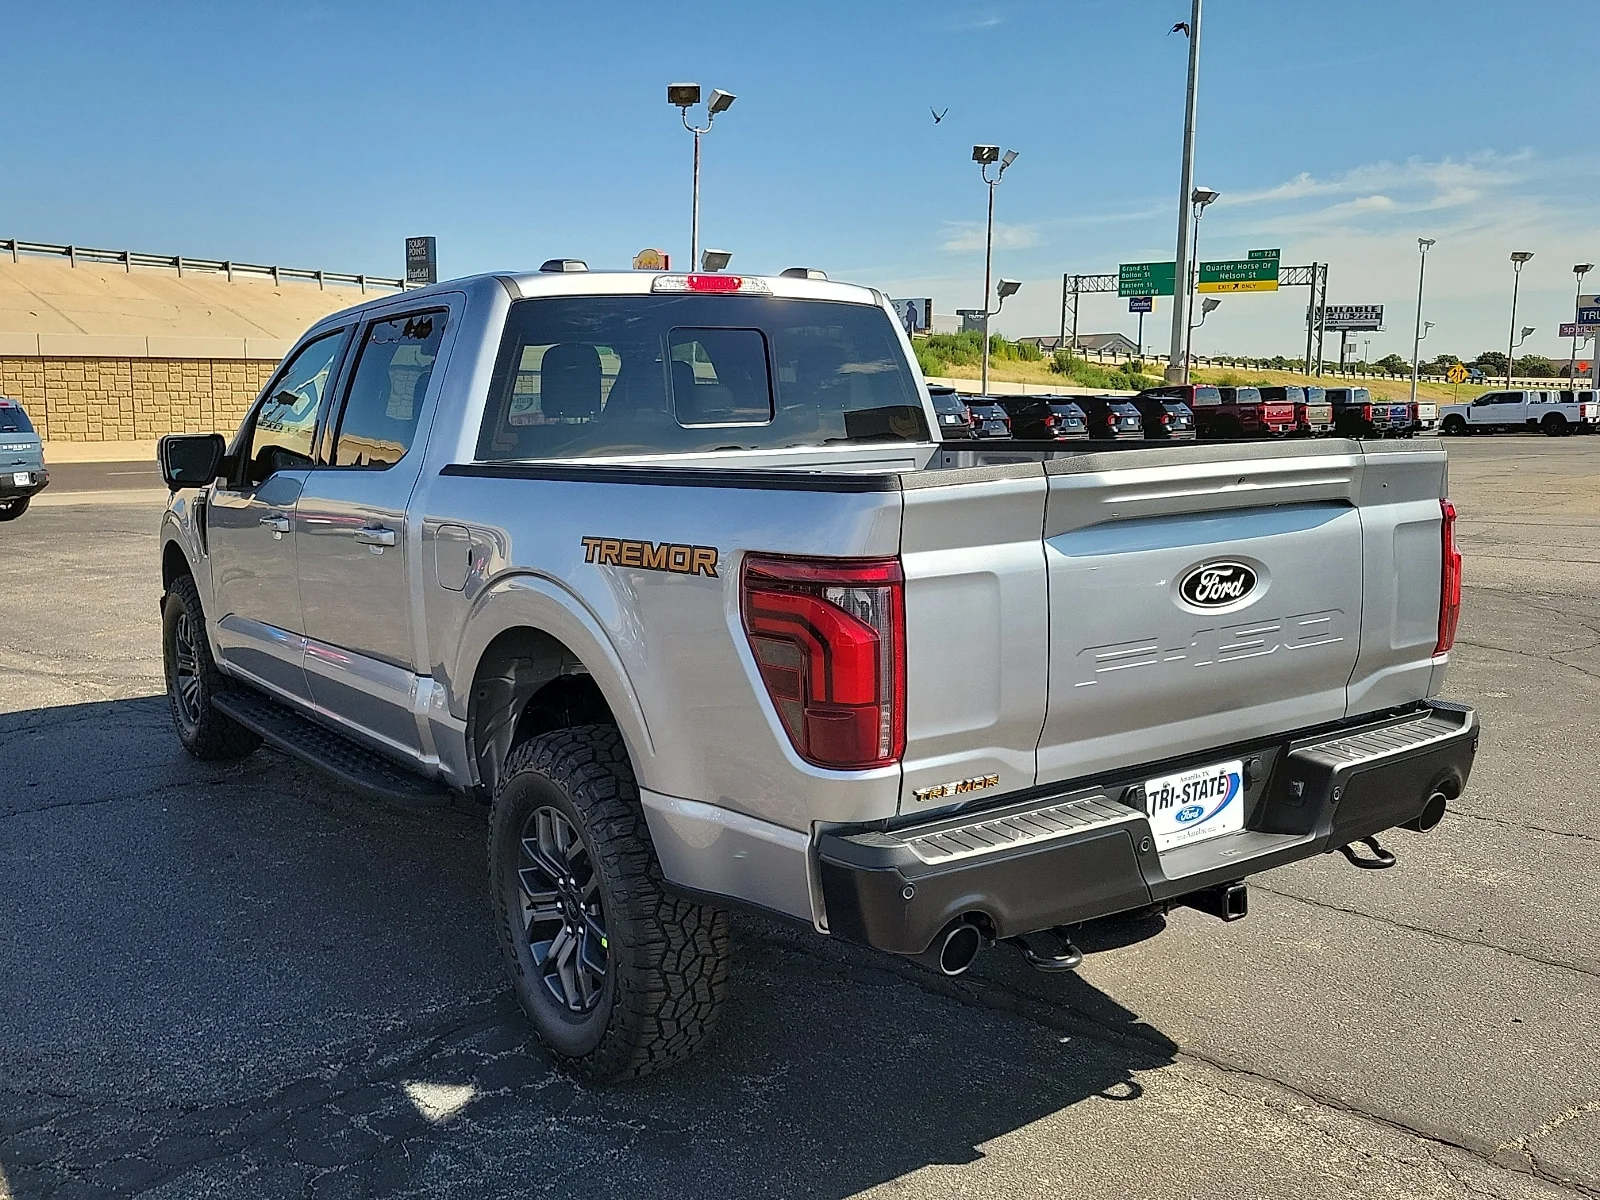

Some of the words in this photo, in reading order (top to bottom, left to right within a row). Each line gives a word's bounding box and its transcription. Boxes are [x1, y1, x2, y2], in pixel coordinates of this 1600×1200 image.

[408, 268, 428, 278] Fairfield
[1205, 264, 1234, 272] Quarter
[1219, 272, 1246, 280] Nelson
[1248, 271, 1257, 279] St
[580, 535, 720, 579] TREMOR
[1195, 568, 1245, 602] Ford
[1074, 607, 1345, 688] F-150
[912, 773, 1000, 802] TREMOR
[1148, 773, 1226, 818] TRI-STATE
